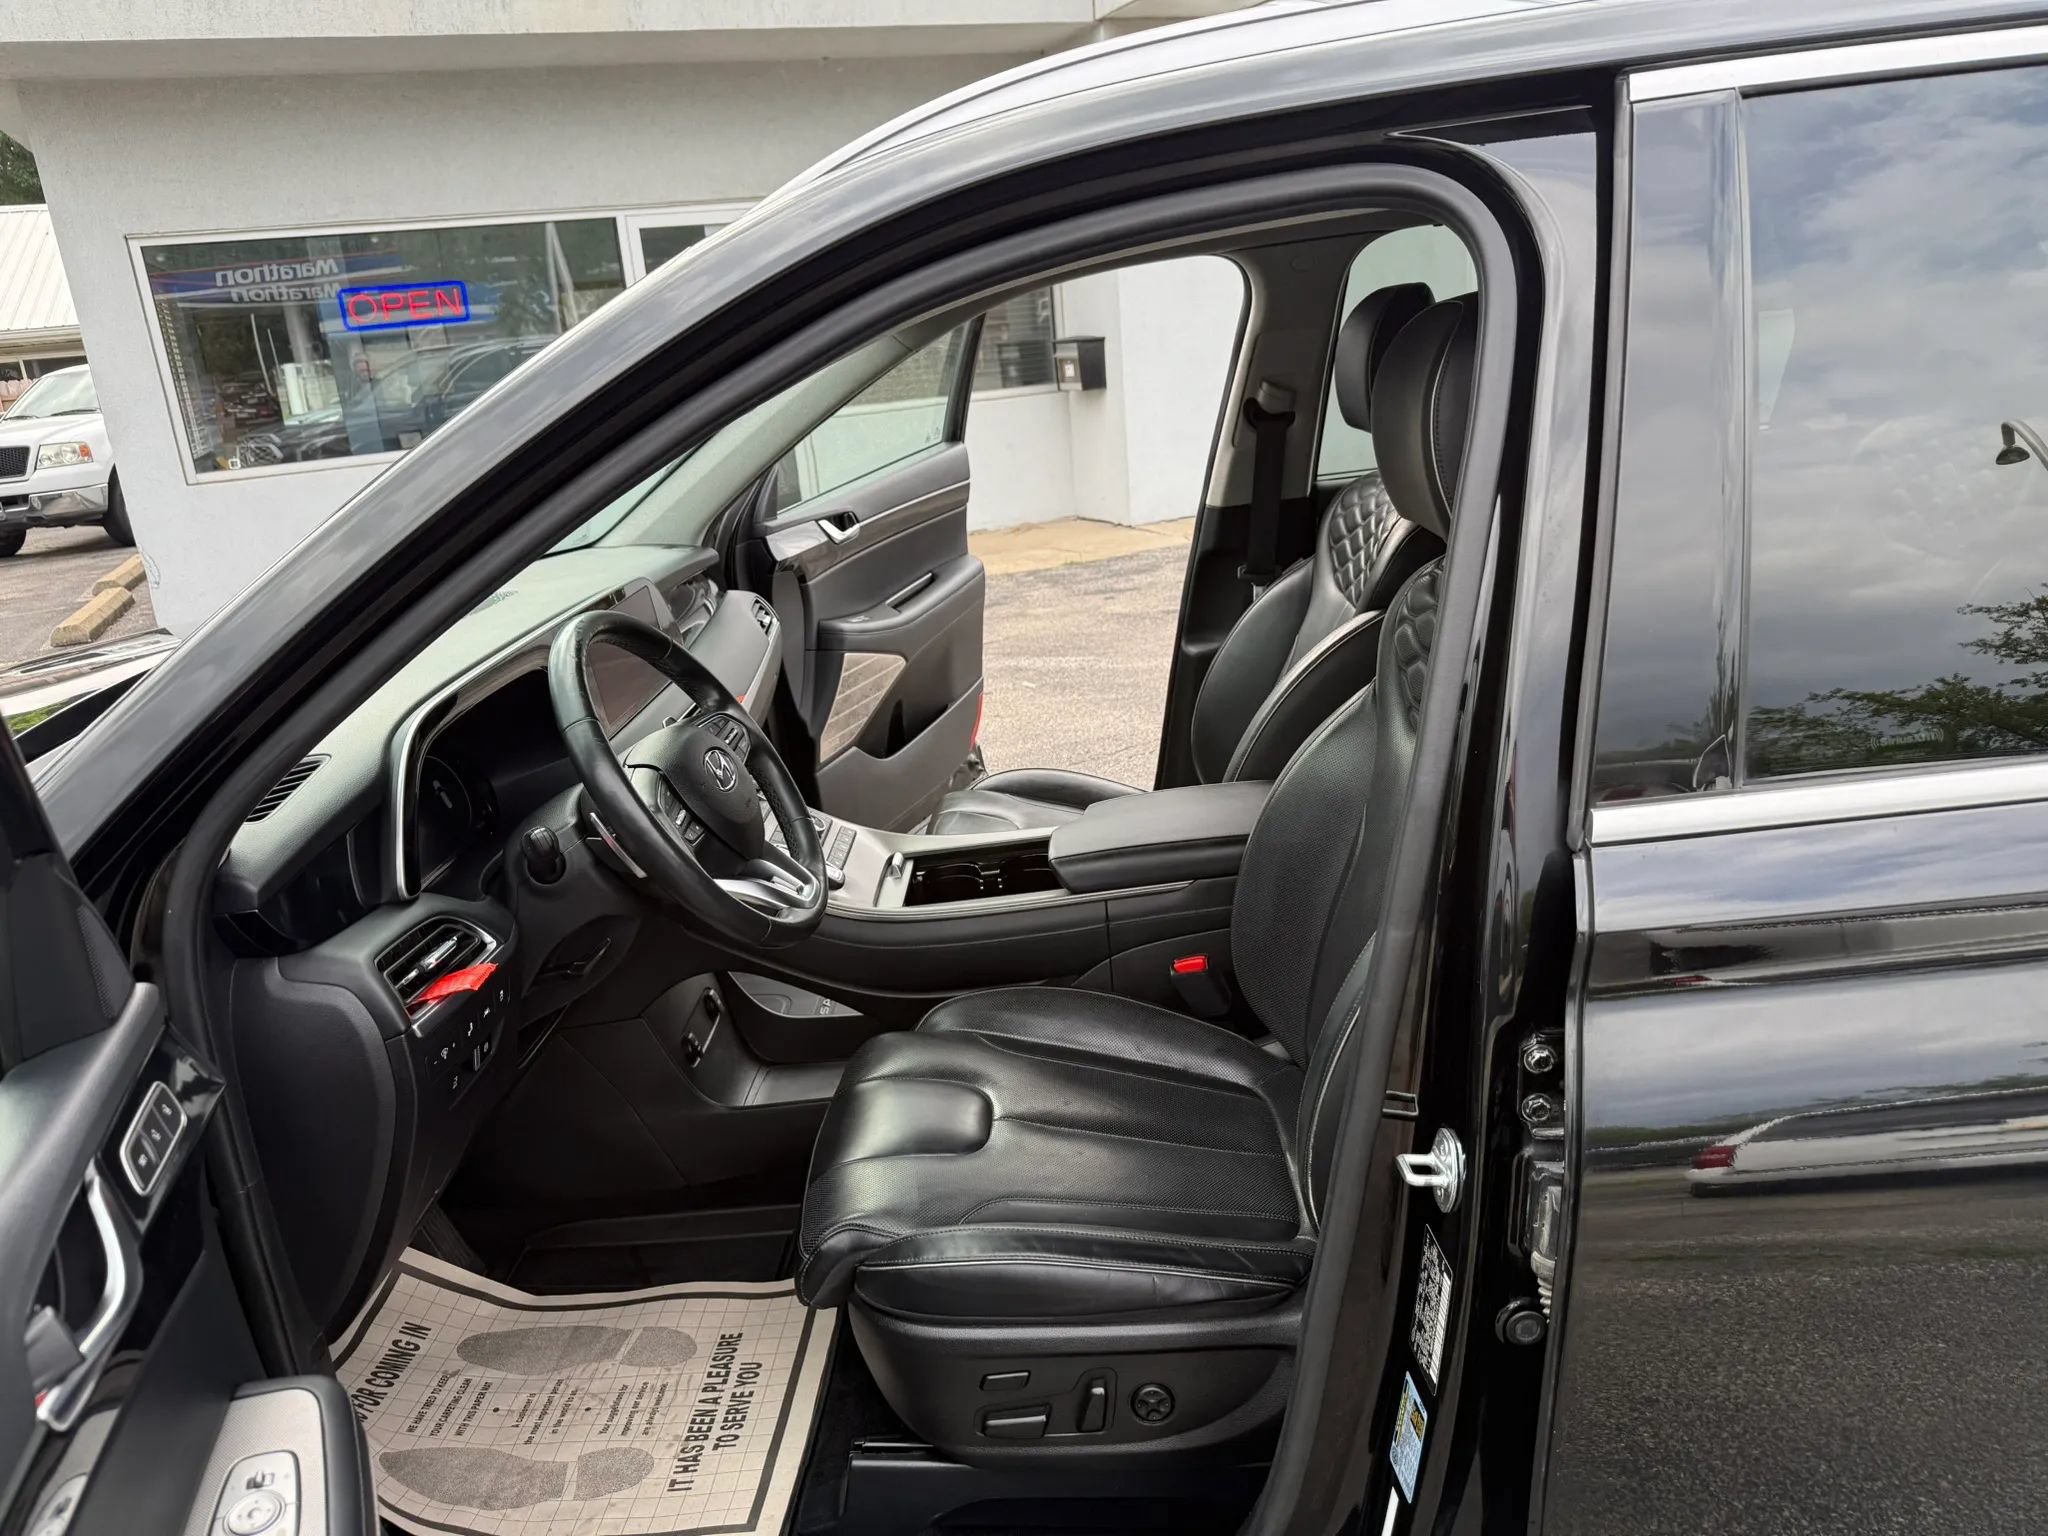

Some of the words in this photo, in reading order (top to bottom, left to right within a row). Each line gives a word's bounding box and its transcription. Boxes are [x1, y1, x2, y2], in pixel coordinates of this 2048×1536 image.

[348, 287, 463, 324] OPEN
[399, 1321, 432, 1340] IN
[365, 1339, 421, 1388] COMING
[701, 1332, 743, 1393] PLEASURE
[436, 1374, 450, 1388] KEEP
[734, 1361, 763, 1389] YOU
[351, 1387, 388, 1413] FOR
[430, 1387, 442, 1395] TO
[636, 1381, 650, 1400] service
[421, 1395, 437, 1410] TRIED
[429, 1422, 445, 1436] YOUR
[438, 1395, 462, 1422] CARPETING
[456, 1378, 473, 1395] CLEAN
[470, 1391, 487, 1410] PAPER
[535, 1395, 555, 1421] important
[698, 1396, 723, 1405] A
[411, 1410, 427, 1424] HAVE
[462, 1410, 477, 1422] THIS
[516, 1398, 533, 1423] customer
[720, 1390, 754, 1431] SERVE
[405, 1424, 419, 1433] WE
[455, 1422, 470, 1436] WITH
[530, 1421, 543, 1435] most
[684, 1408, 719, 1442] BEEN
[712, 1434, 740, 1451] TO
[673, 1444, 705, 1474] HAS
[667, 1478, 695, 1492] IT
